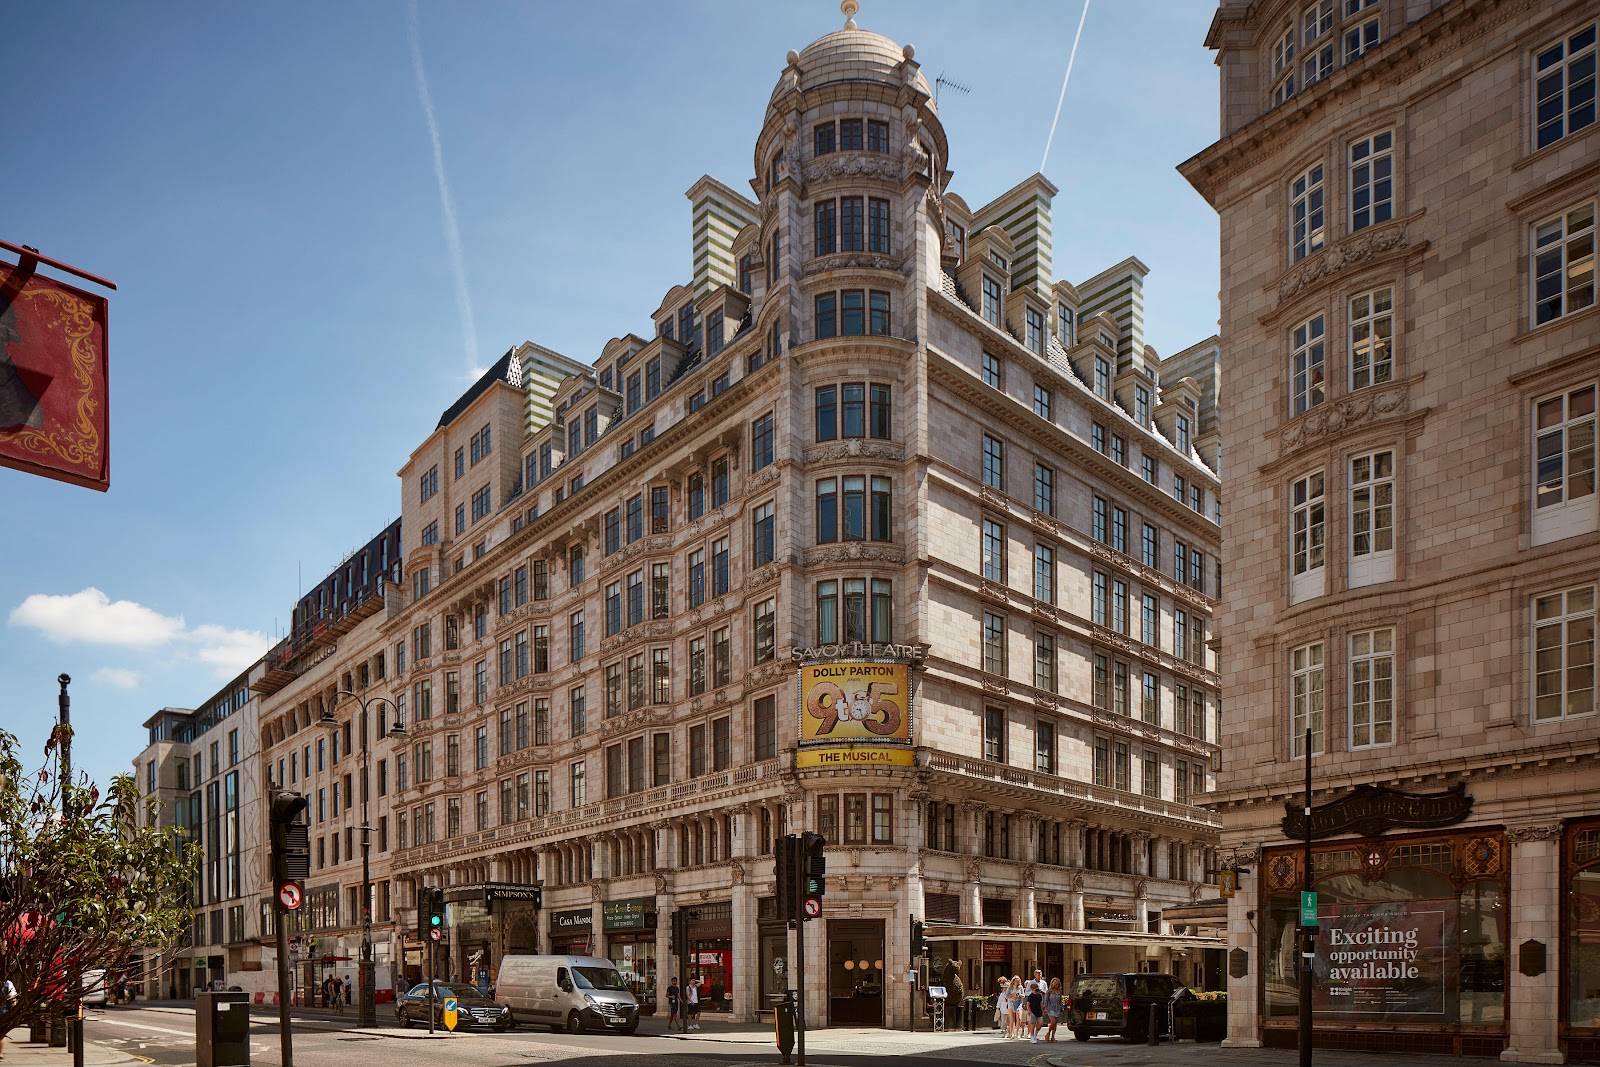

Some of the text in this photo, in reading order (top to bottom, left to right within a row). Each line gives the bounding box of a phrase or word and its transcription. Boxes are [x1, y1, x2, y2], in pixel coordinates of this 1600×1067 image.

[792, 641, 922, 661] SAVOY THEATRE
[813, 666, 893, 677] DOLLY PARTON
[819, 752, 892, 762] THE MUSICAL
[494, 890, 534, 899] SIMPSON'S
[1330, 926, 1419, 948] Exciting
[1329, 947, 1418, 964] opportunity
[1330, 962, 1419, 980] available
